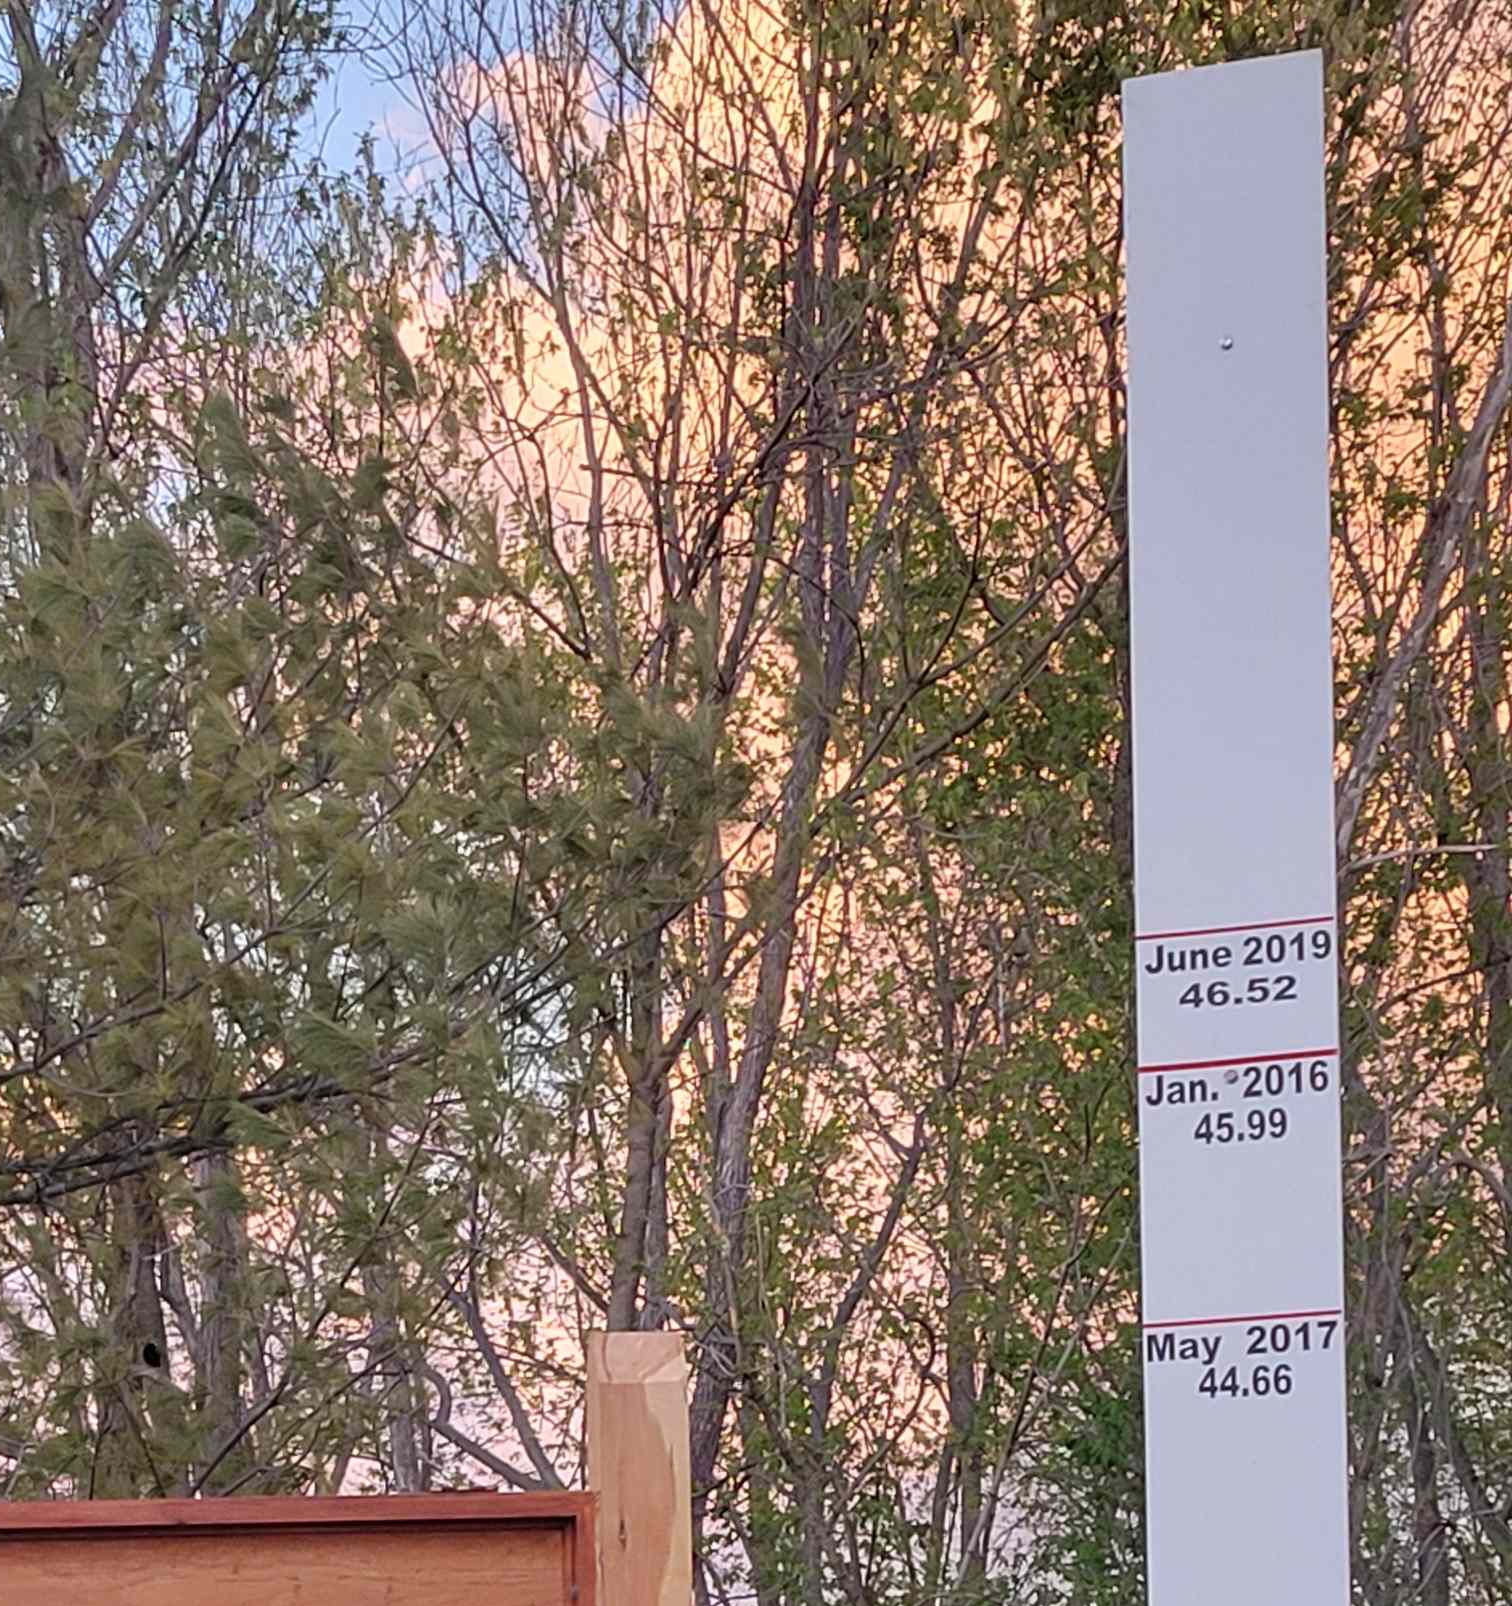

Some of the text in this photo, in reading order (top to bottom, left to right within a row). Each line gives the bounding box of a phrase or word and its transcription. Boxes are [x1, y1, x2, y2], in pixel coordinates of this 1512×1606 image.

[1145, 930, 1331, 974] June 2019
[1179, 976, 1297, 1008] 46.52
[1146, 1061, 1328, 1106] Jan. 2016
[1195, 1108, 1287, 1144] 45.99
[1147, 1320, 1338, 1365] May 2017
[1199, 1365, 1292, 1398] 44.66
